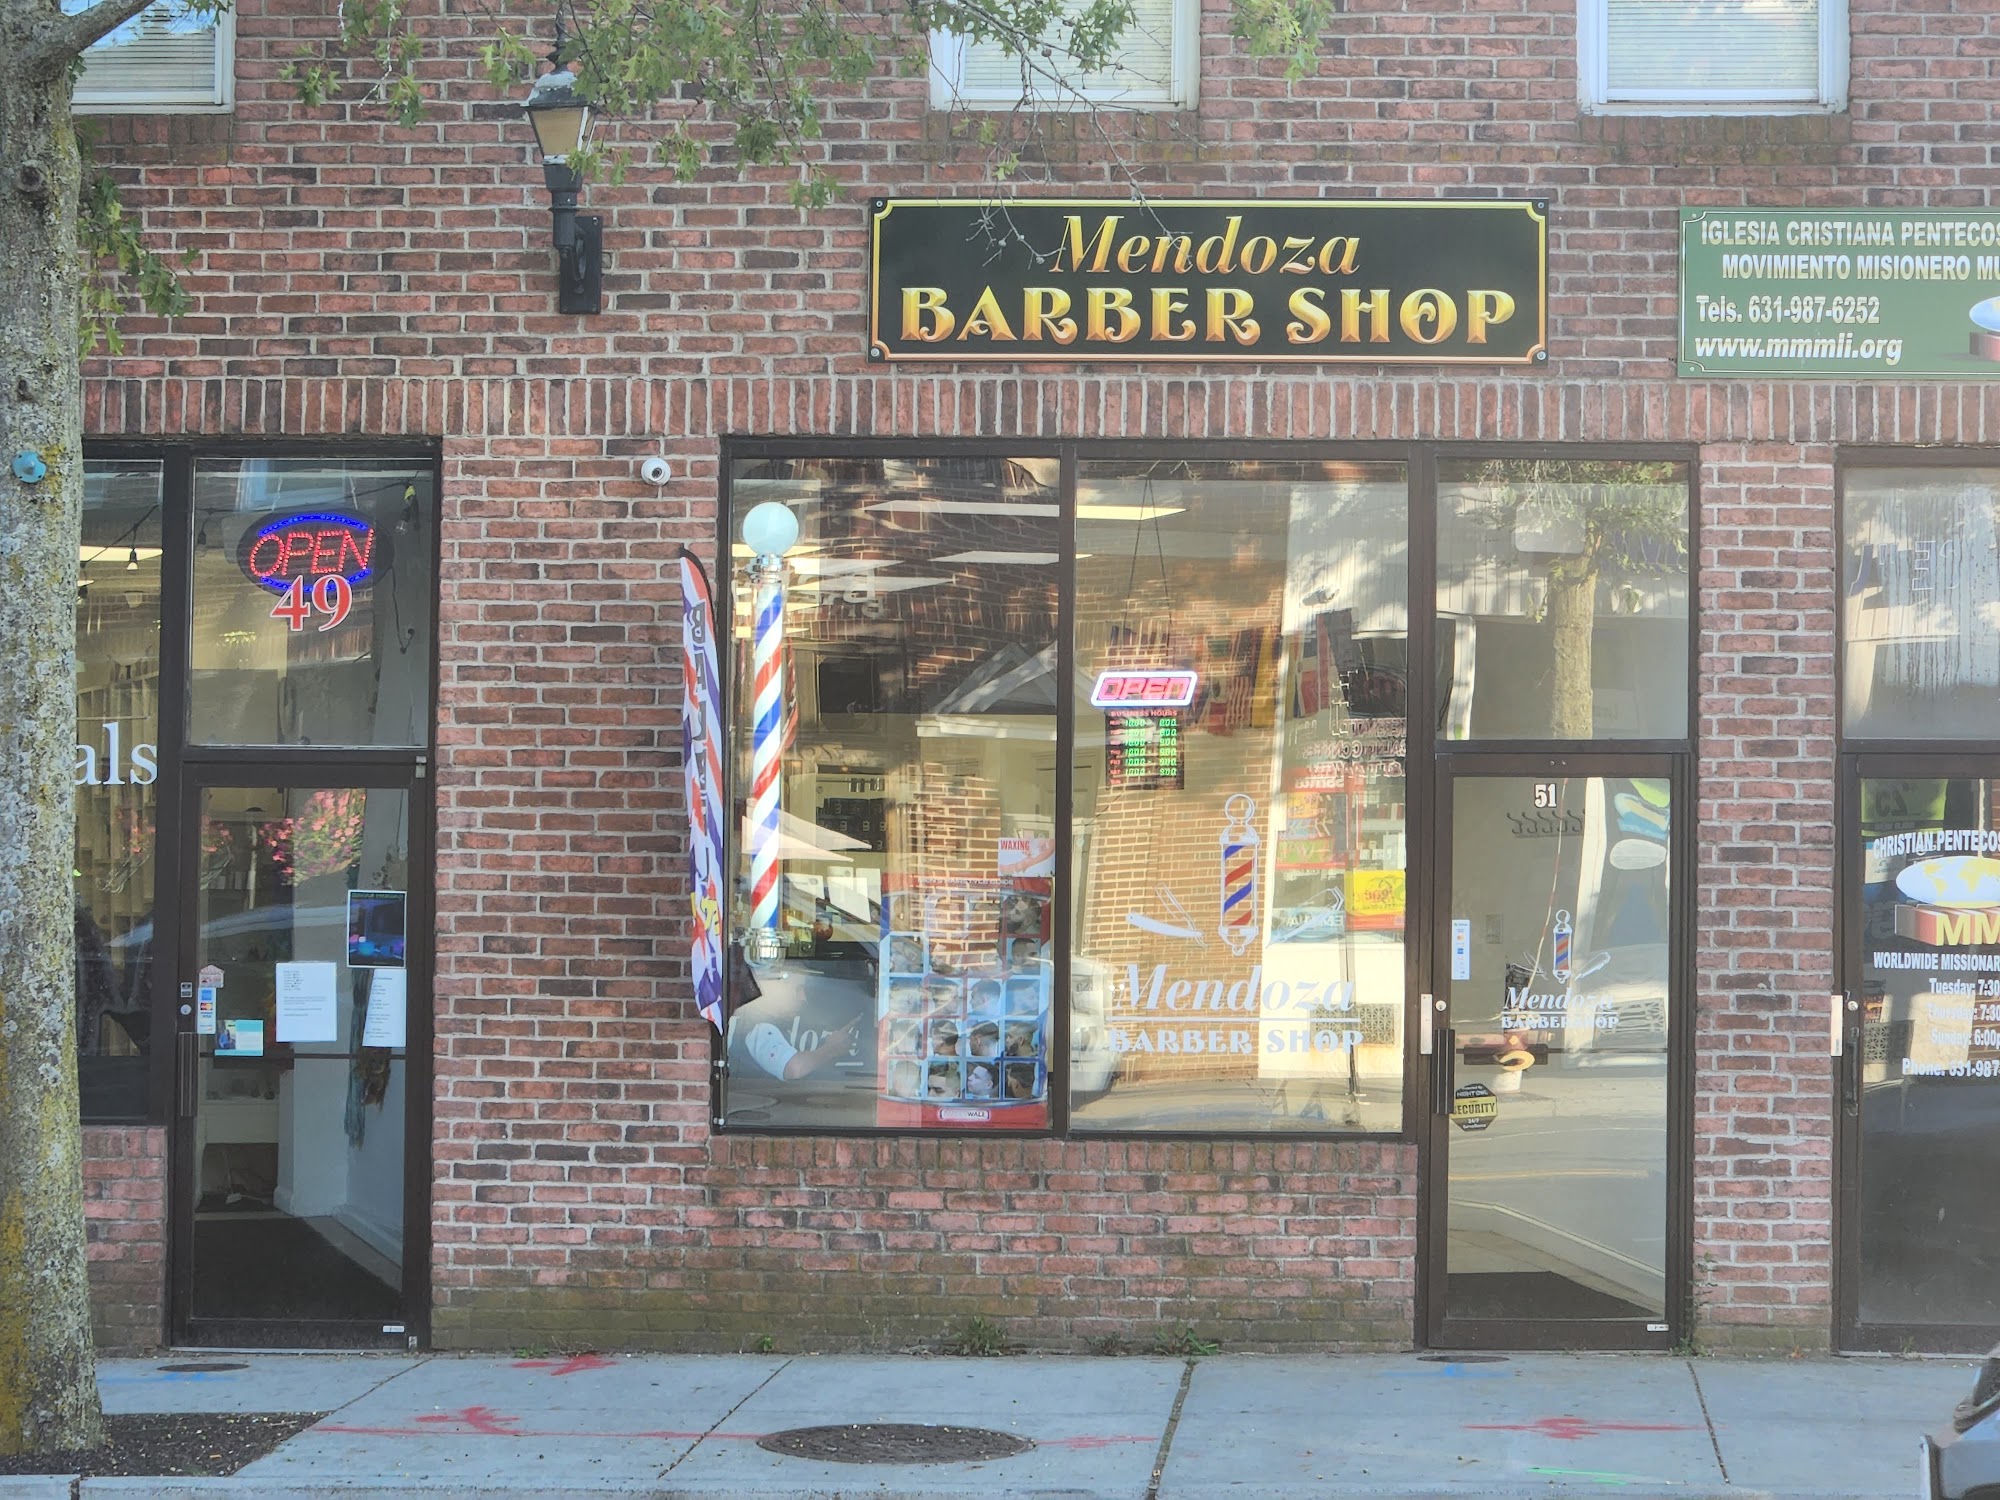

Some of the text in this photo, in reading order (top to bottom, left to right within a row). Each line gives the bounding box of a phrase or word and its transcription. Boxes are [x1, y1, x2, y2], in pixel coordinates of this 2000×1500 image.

[1049, 215, 1361, 275] Mendoza
[1702, 220, 2000, 247] IGLESIA CRISTIANA PENTECO
[1722, 254, 1851, 280] MOVIMIENTO
[1857, 255, 1971, 281] MISIONERO
[900, 285, 1516, 345] BARBER SHOP
[1696, 295, 1880, 324] Tels. 631-987-6252
[1695, 332, 1903, 366] www.mmmli.org
[250, 528, 375, 577] OPEN
[270, 574, 353, 632] 49
[1098, 677, 1190, 701] OPEN
[1534, 784, 1557, 808] 51
[1000, 840, 1030, 850] WAXING
[1873, 830, 2000, 859] CHRISTIAN PENTECO
[1873, 952, 1938, 970] WORLDWIDE
[1114, 964, 1356, 1012] Mendoza
[1503, 986, 1615, 1010] Mendoza
[1929, 978, 1976, 998] Tuesday:
[1501, 1016, 1573, 1029] BARBER
[1107, 1029, 1364, 1055] BARBER SHOP
